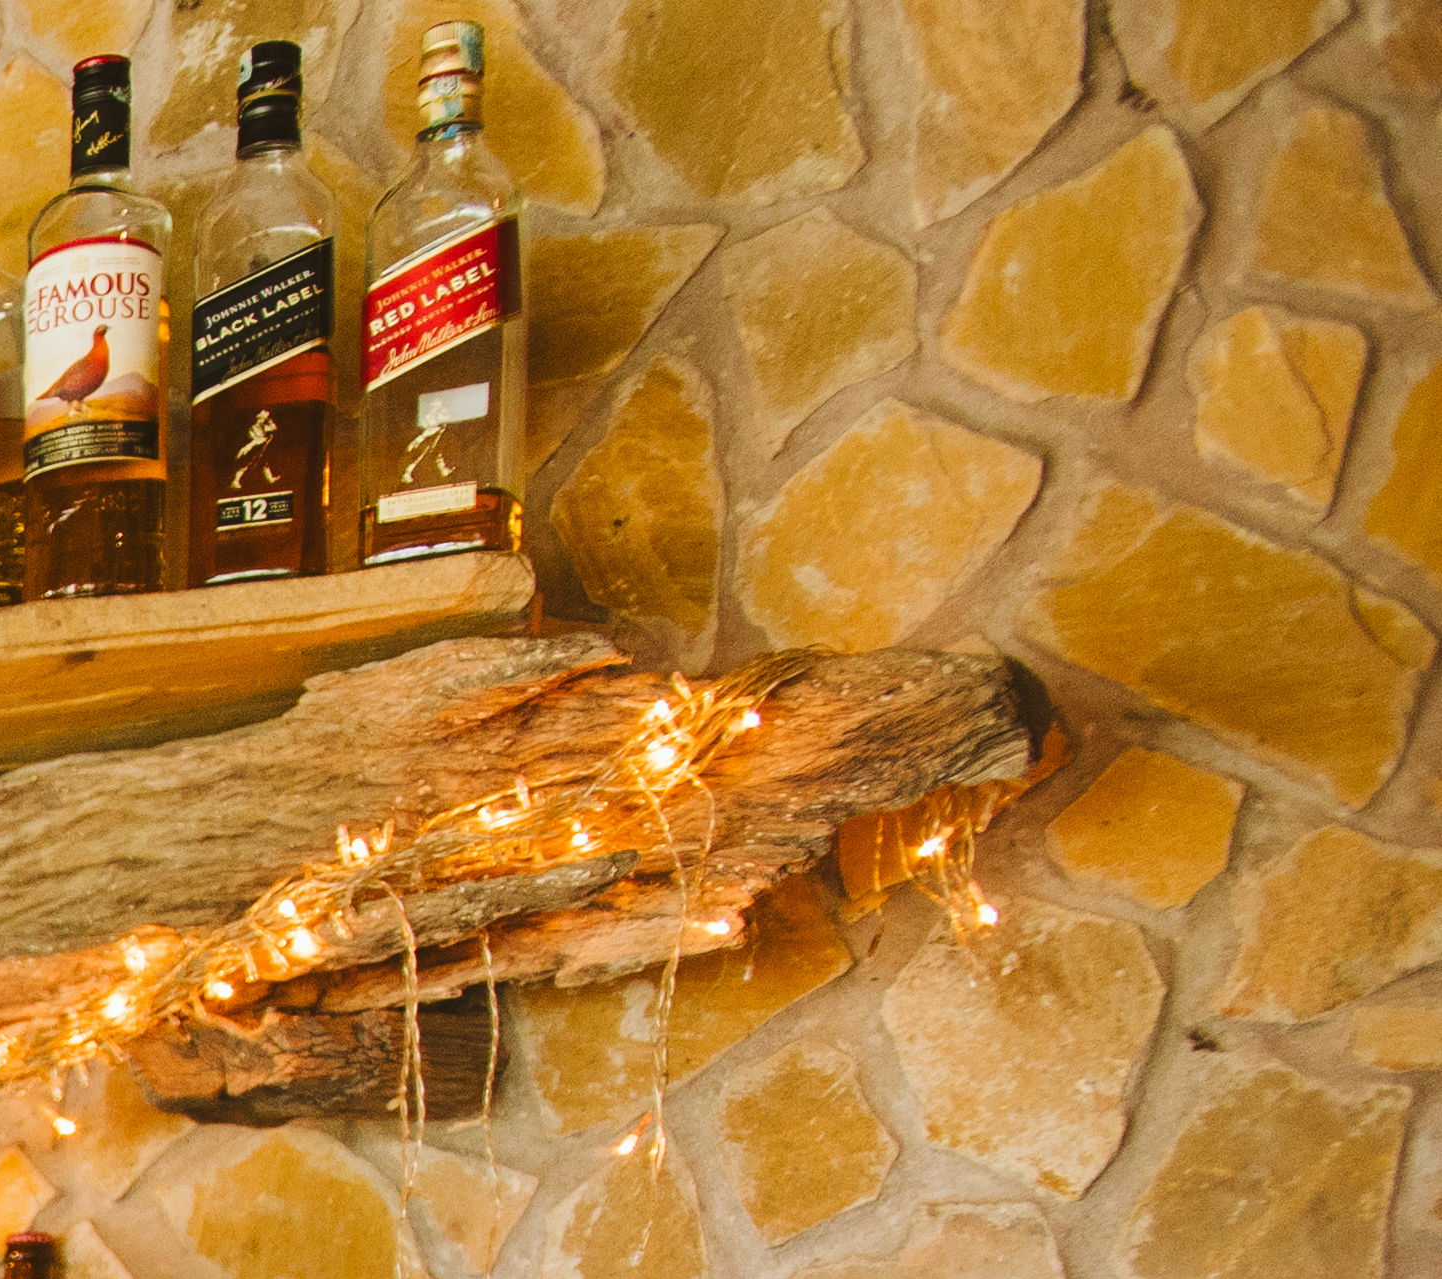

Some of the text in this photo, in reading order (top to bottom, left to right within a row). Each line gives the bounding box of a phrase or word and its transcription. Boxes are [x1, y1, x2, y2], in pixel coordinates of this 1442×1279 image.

[37, 272, 150, 312] FAMOUS
[368, 261, 496, 337] RED LABEL
[377, 276, 430, 313] JOHNNIE
[36, 297, 150, 332] GROUSE
[195, 283, 324, 352] BLACK LABEL
[206, 294, 260, 330] JOHNNIE
[243, 499, 268, 521] 12
